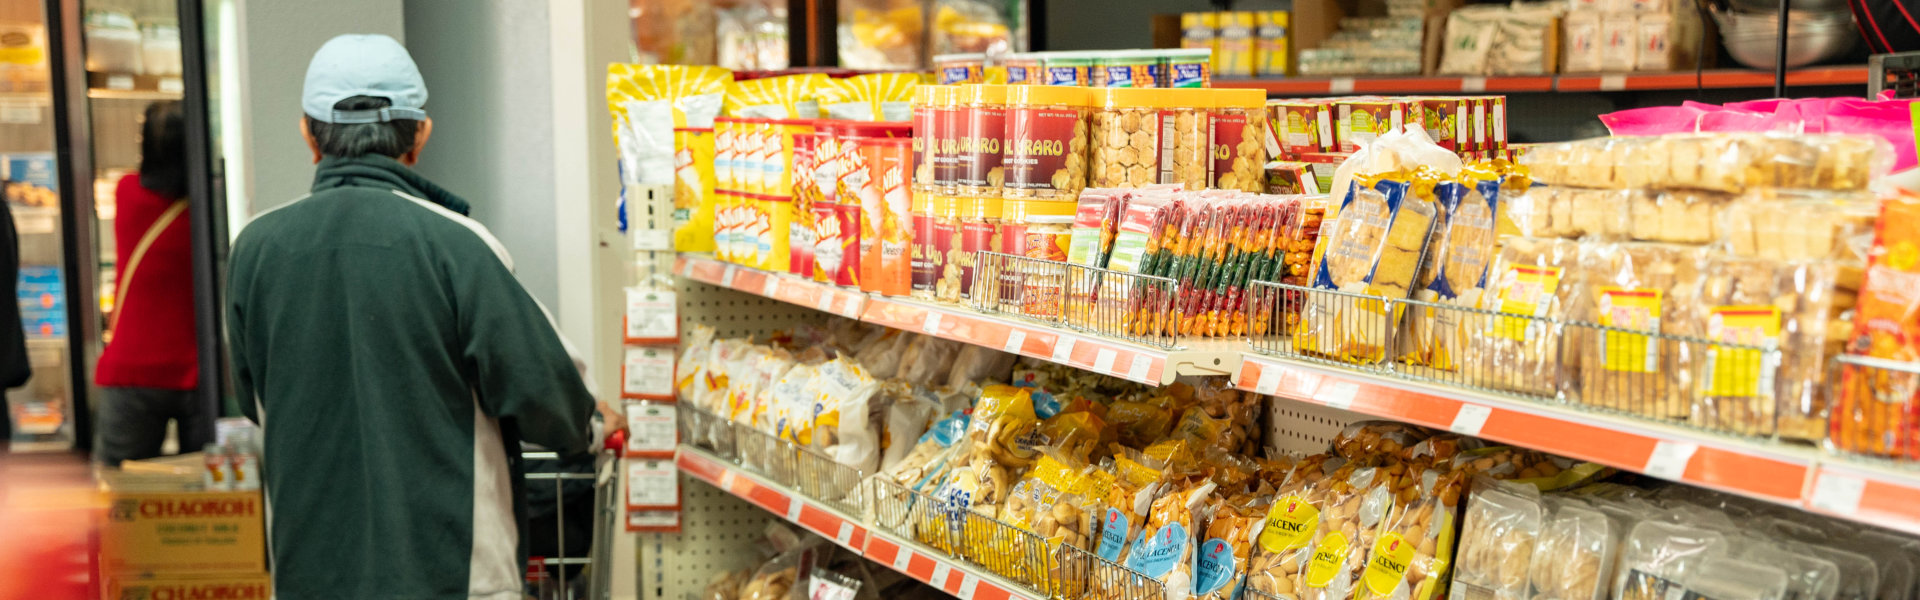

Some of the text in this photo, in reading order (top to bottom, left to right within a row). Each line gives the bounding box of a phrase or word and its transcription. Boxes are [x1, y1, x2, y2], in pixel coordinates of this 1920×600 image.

[1015, 139, 1063, 156] URARO
[950, 488, 971, 508] EGG
[139, 500, 255, 518] CHAOKOH
[151, 584, 266, 600] CHAOKOH
